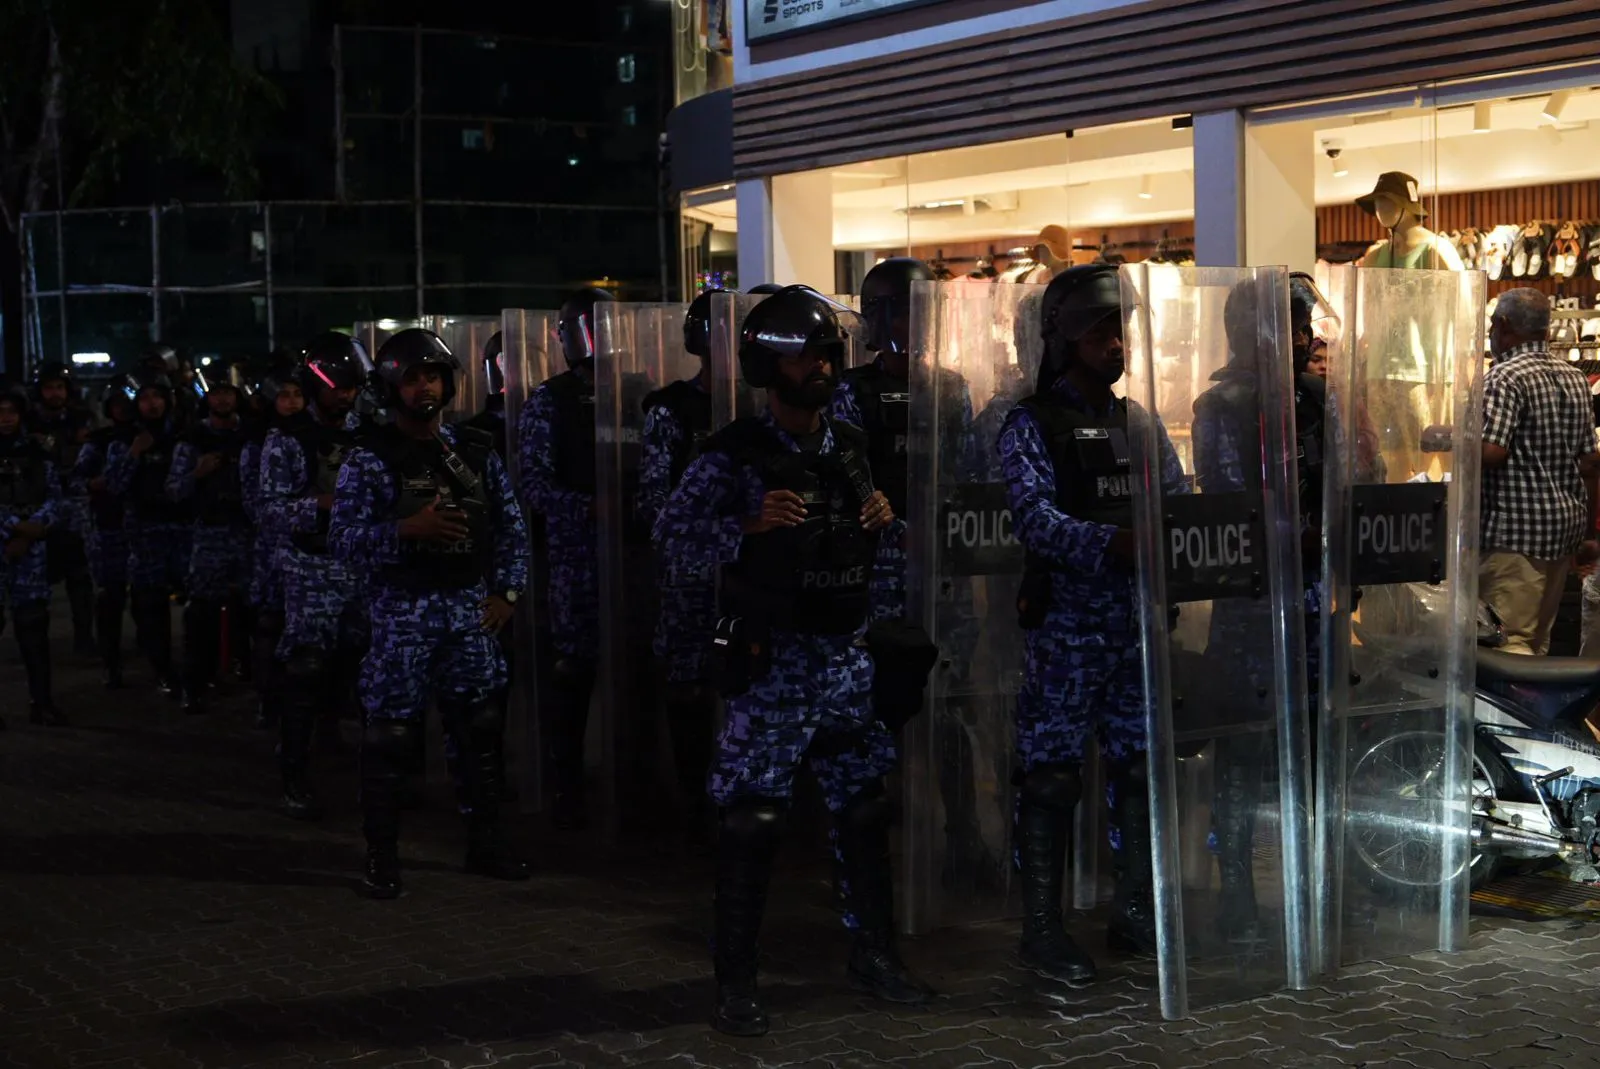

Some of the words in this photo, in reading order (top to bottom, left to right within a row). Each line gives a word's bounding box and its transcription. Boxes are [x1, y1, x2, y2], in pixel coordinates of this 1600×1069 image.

[783, 1, 824, 18] SPORTS
[947, 508, 1021, 549] POLIC
[1170, 523, 1253, 570] POLICE
[1358, 512, 1436, 555] POLICE
[802, 564, 865, 589] POLICE
